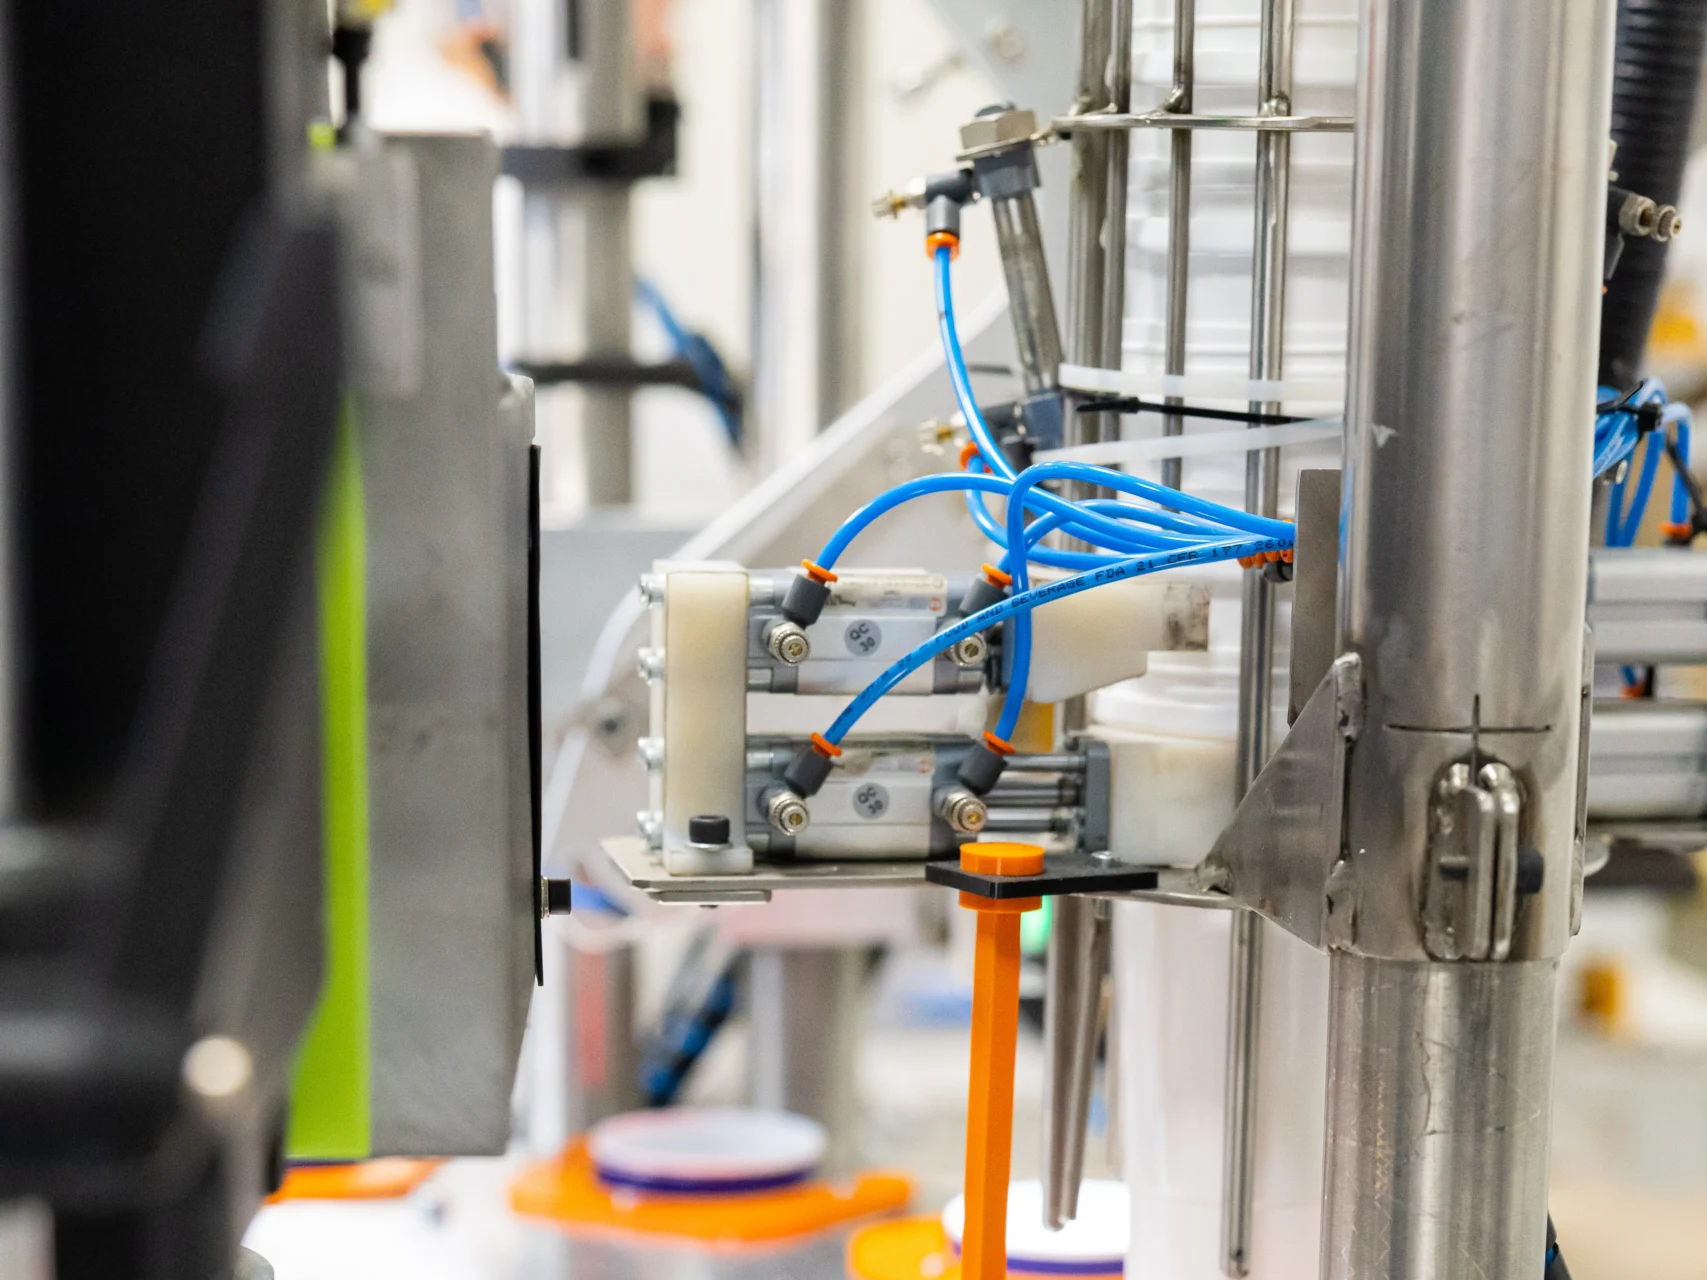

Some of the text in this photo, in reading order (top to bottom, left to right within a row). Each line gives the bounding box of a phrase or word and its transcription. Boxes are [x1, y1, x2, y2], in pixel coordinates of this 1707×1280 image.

[1011, 576, 1085, 608] BEVERAGE
[1095, 567, 1126, 581] FDA
[1136, 560, 1153, 572] 21
[849, 623, 869, 641] QC
